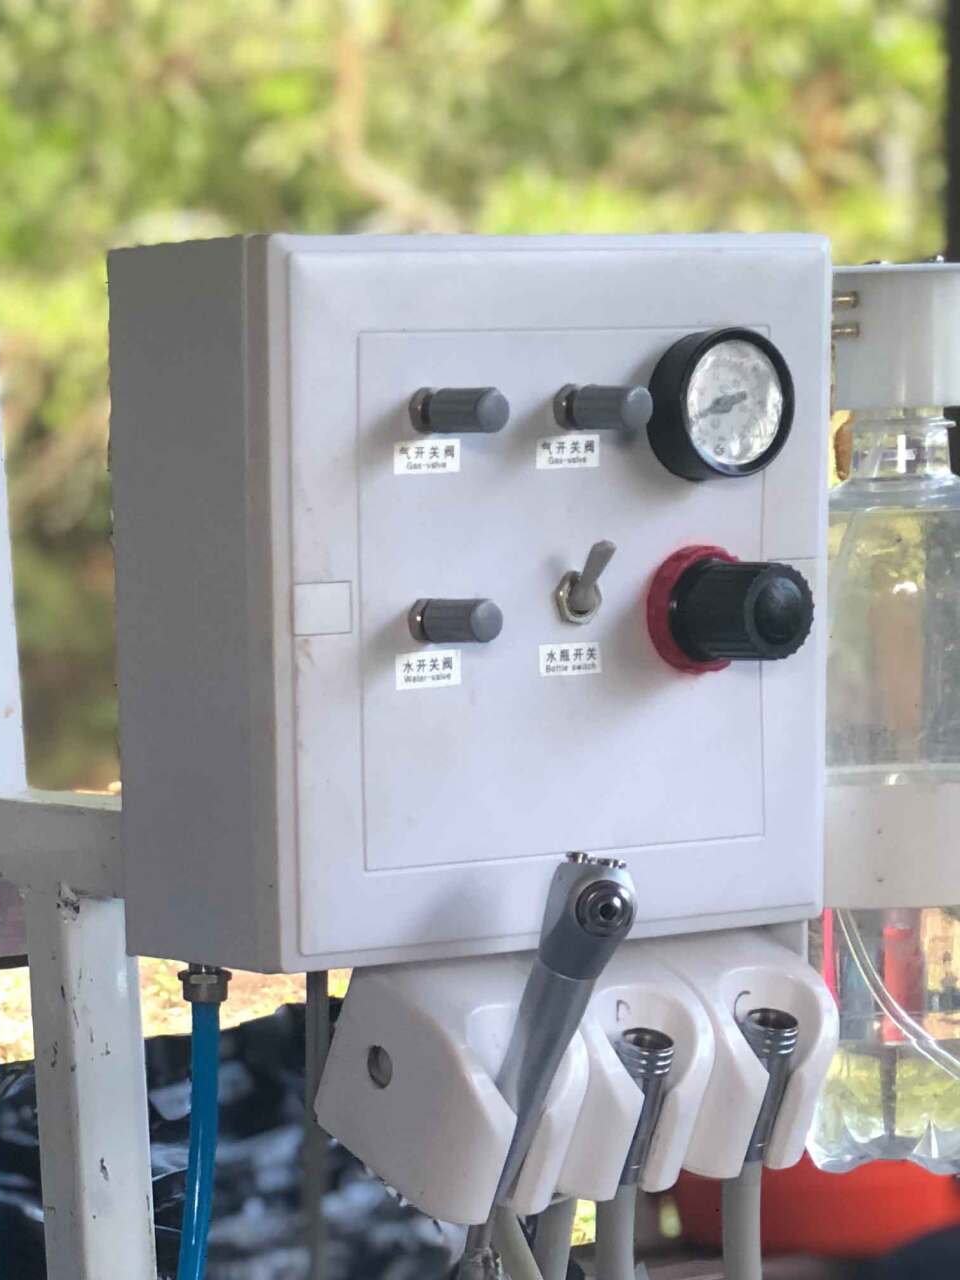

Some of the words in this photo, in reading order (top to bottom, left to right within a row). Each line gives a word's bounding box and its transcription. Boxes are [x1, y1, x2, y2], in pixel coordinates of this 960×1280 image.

[399, 445, 456, 460] 气开关阀
[541, 439, 595, 456] 气开关阀
[546, 647, 598, 663] 水瓶开关
[402, 656, 454, 674] 水开关阀
